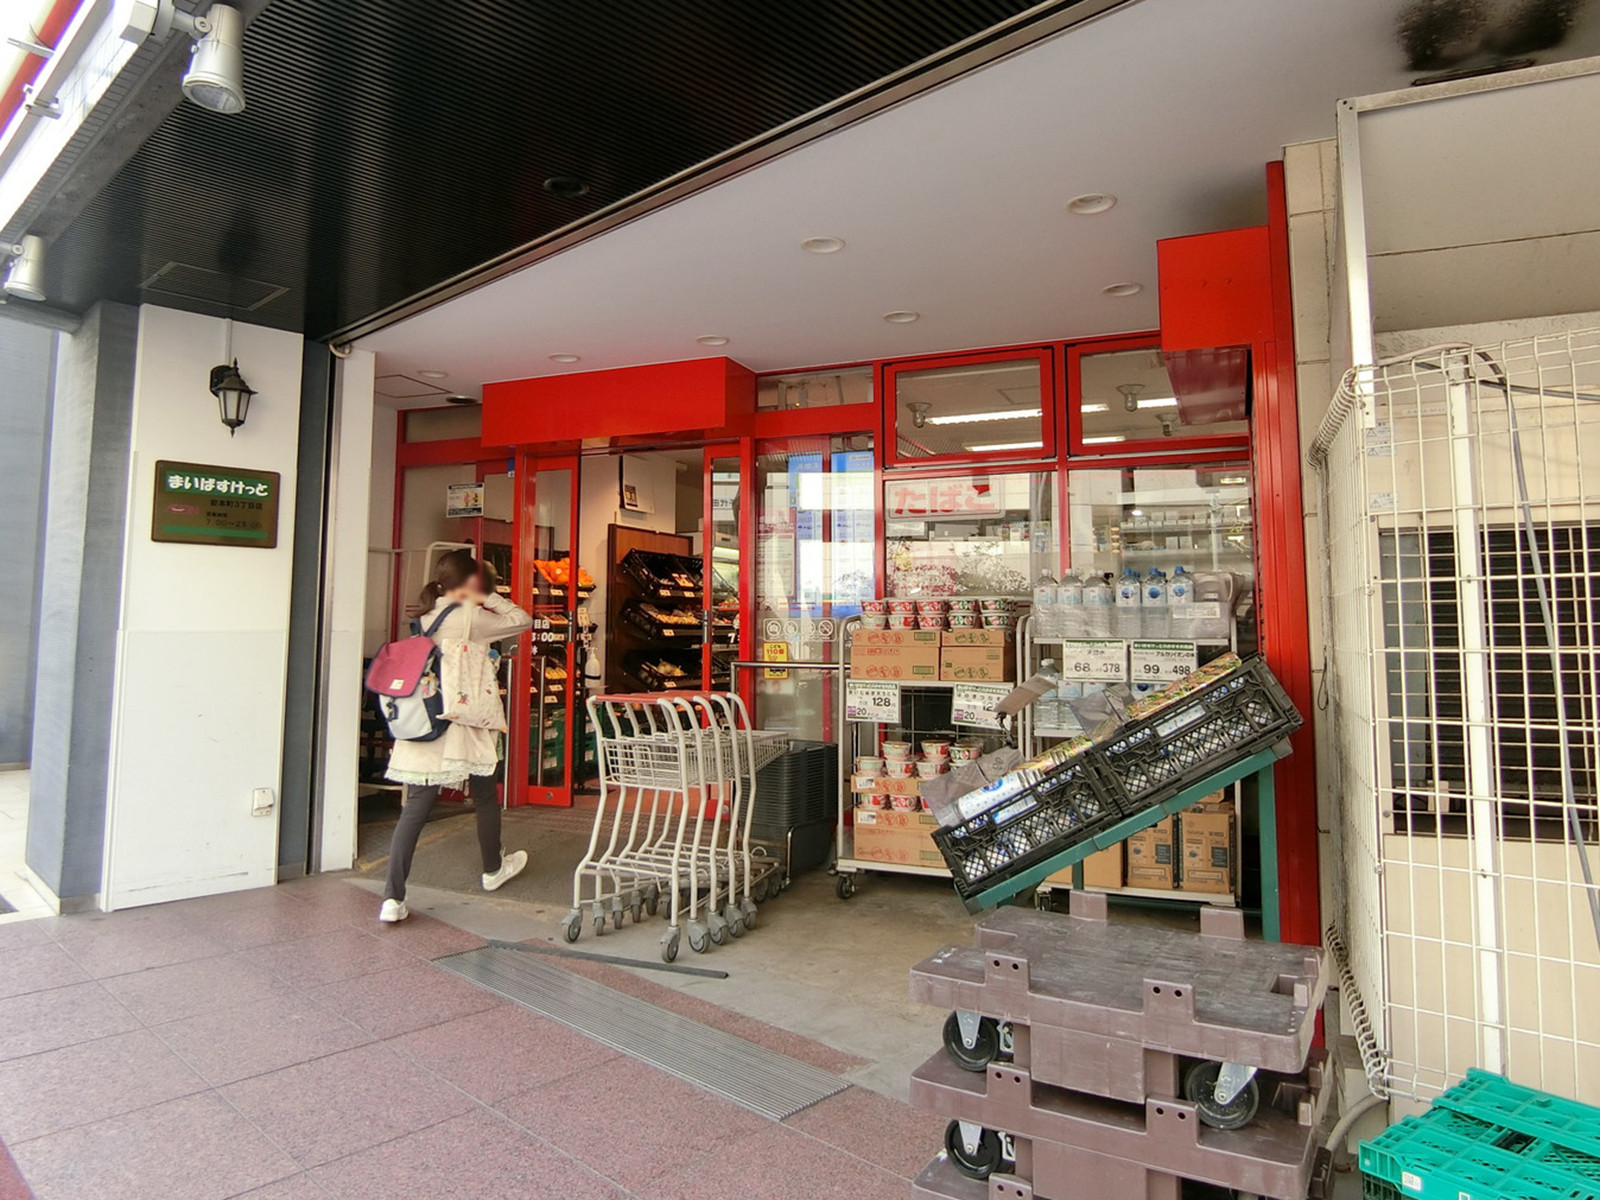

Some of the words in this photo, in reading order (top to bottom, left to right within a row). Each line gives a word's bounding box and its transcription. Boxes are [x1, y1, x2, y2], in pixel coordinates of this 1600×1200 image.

[168, 474, 269, 497] まいばすけっと
[894, 483, 996, 515] たばこ
[1074, 662, 1091, 673] 68
[1102, 662, 1121, 673] 378
[1143, 664, 1160, 674] 99
[1172, 665, 1191, 675] 498
[872, 697, 891, 707] 128
[856, 707, 867, 716] 20
[964, 711, 975, 720] 20
